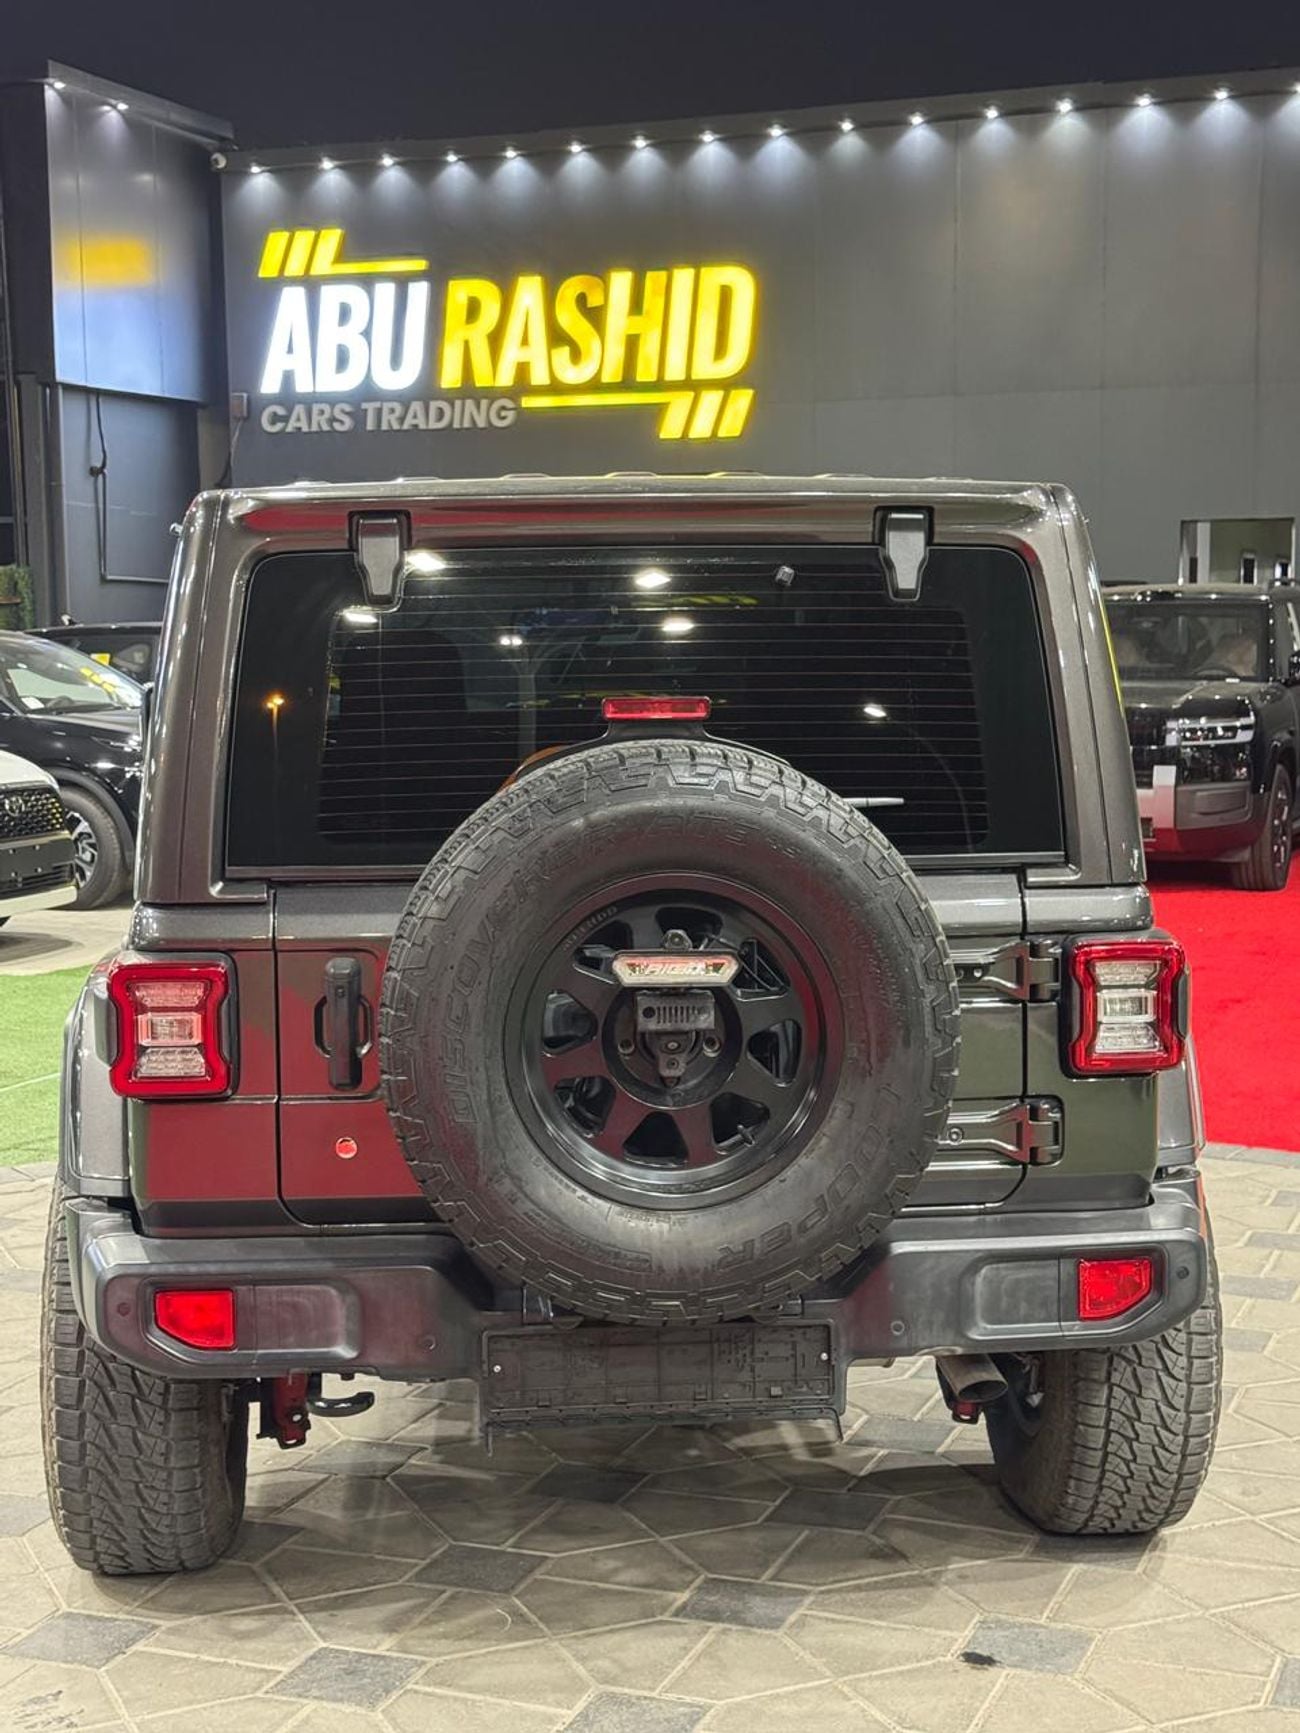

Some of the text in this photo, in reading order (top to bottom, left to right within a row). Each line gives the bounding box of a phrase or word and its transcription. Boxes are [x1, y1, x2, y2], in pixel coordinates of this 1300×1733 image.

[260, 265, 757, 394] ABU RASHID
[261, 398, 518, 433] CARS TRADING
[716, 1082, 903, 1271] OOPER
